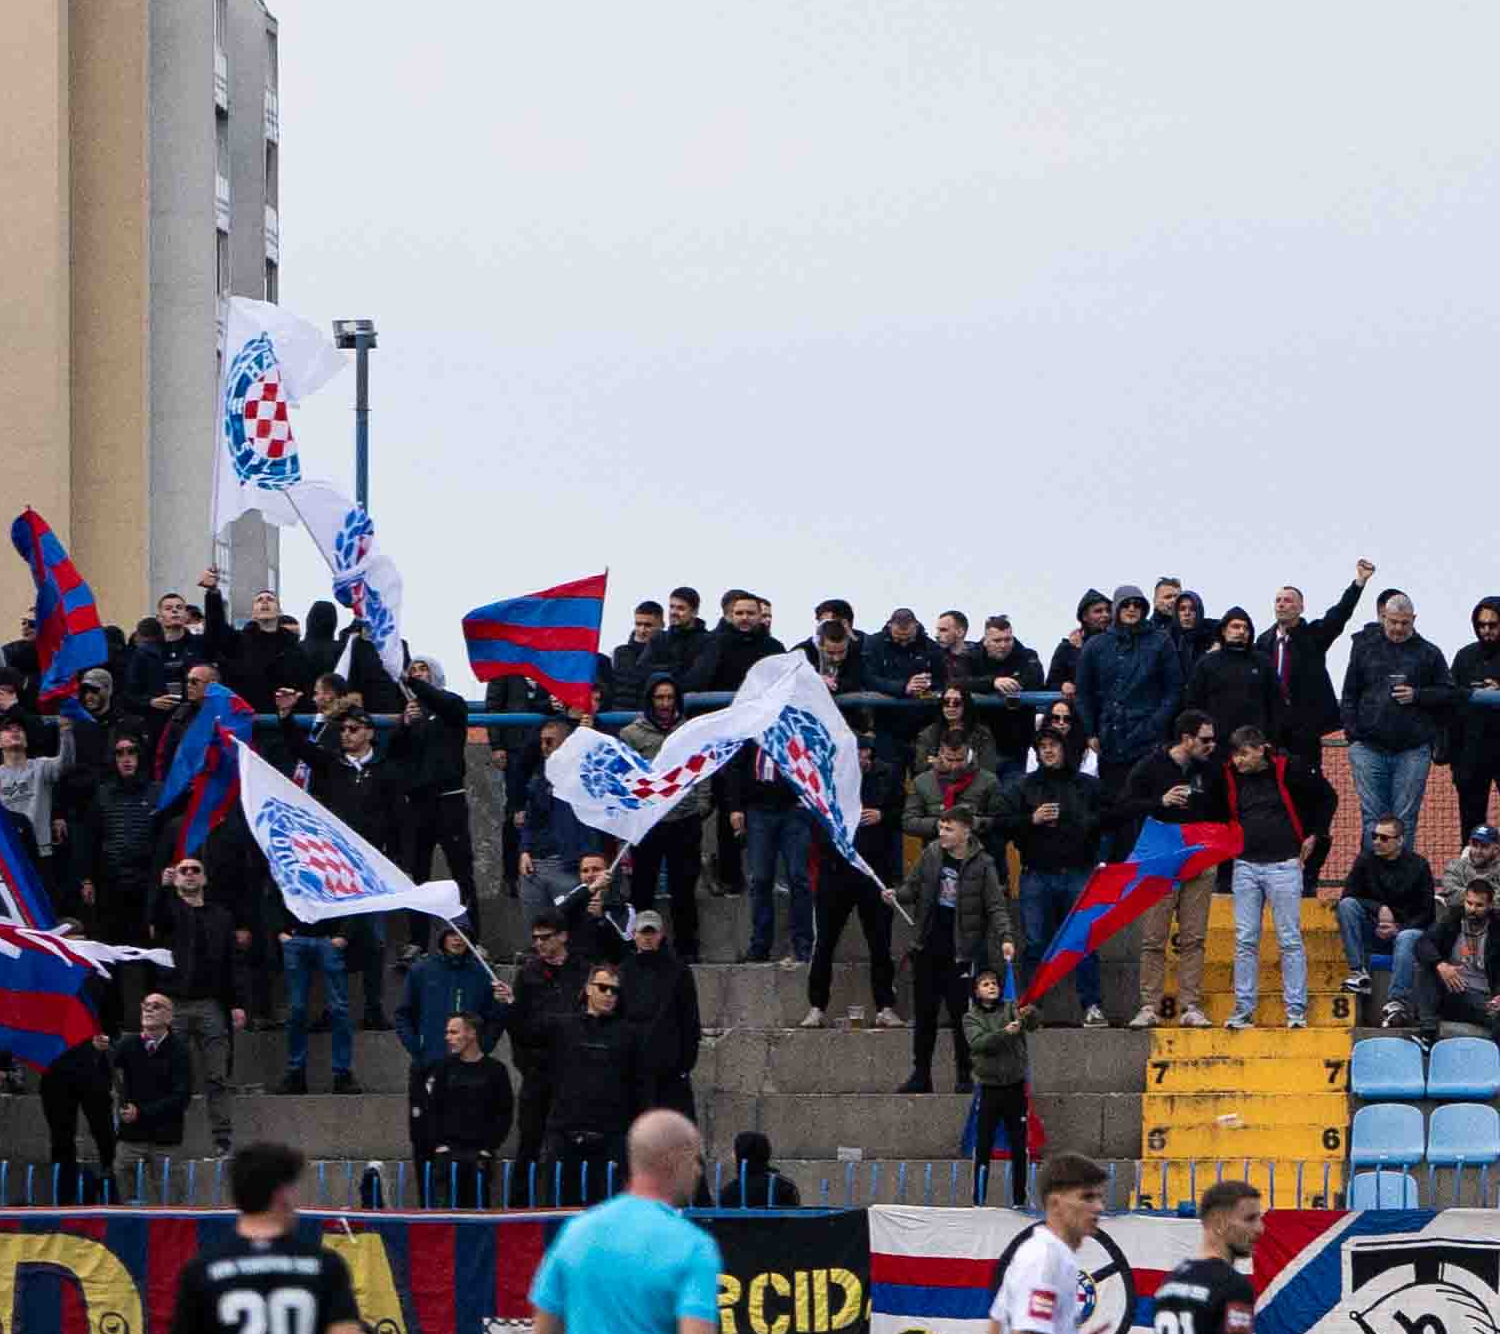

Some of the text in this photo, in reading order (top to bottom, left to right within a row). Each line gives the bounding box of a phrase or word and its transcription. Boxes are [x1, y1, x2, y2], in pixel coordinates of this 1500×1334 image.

[1332, 997, 1350, 1018] 8
[1152, 1061, 1169, 1083] 7
[1325, 1060, 1343, 1083] 7
[1322, 1127, 1341, 1150] 6
